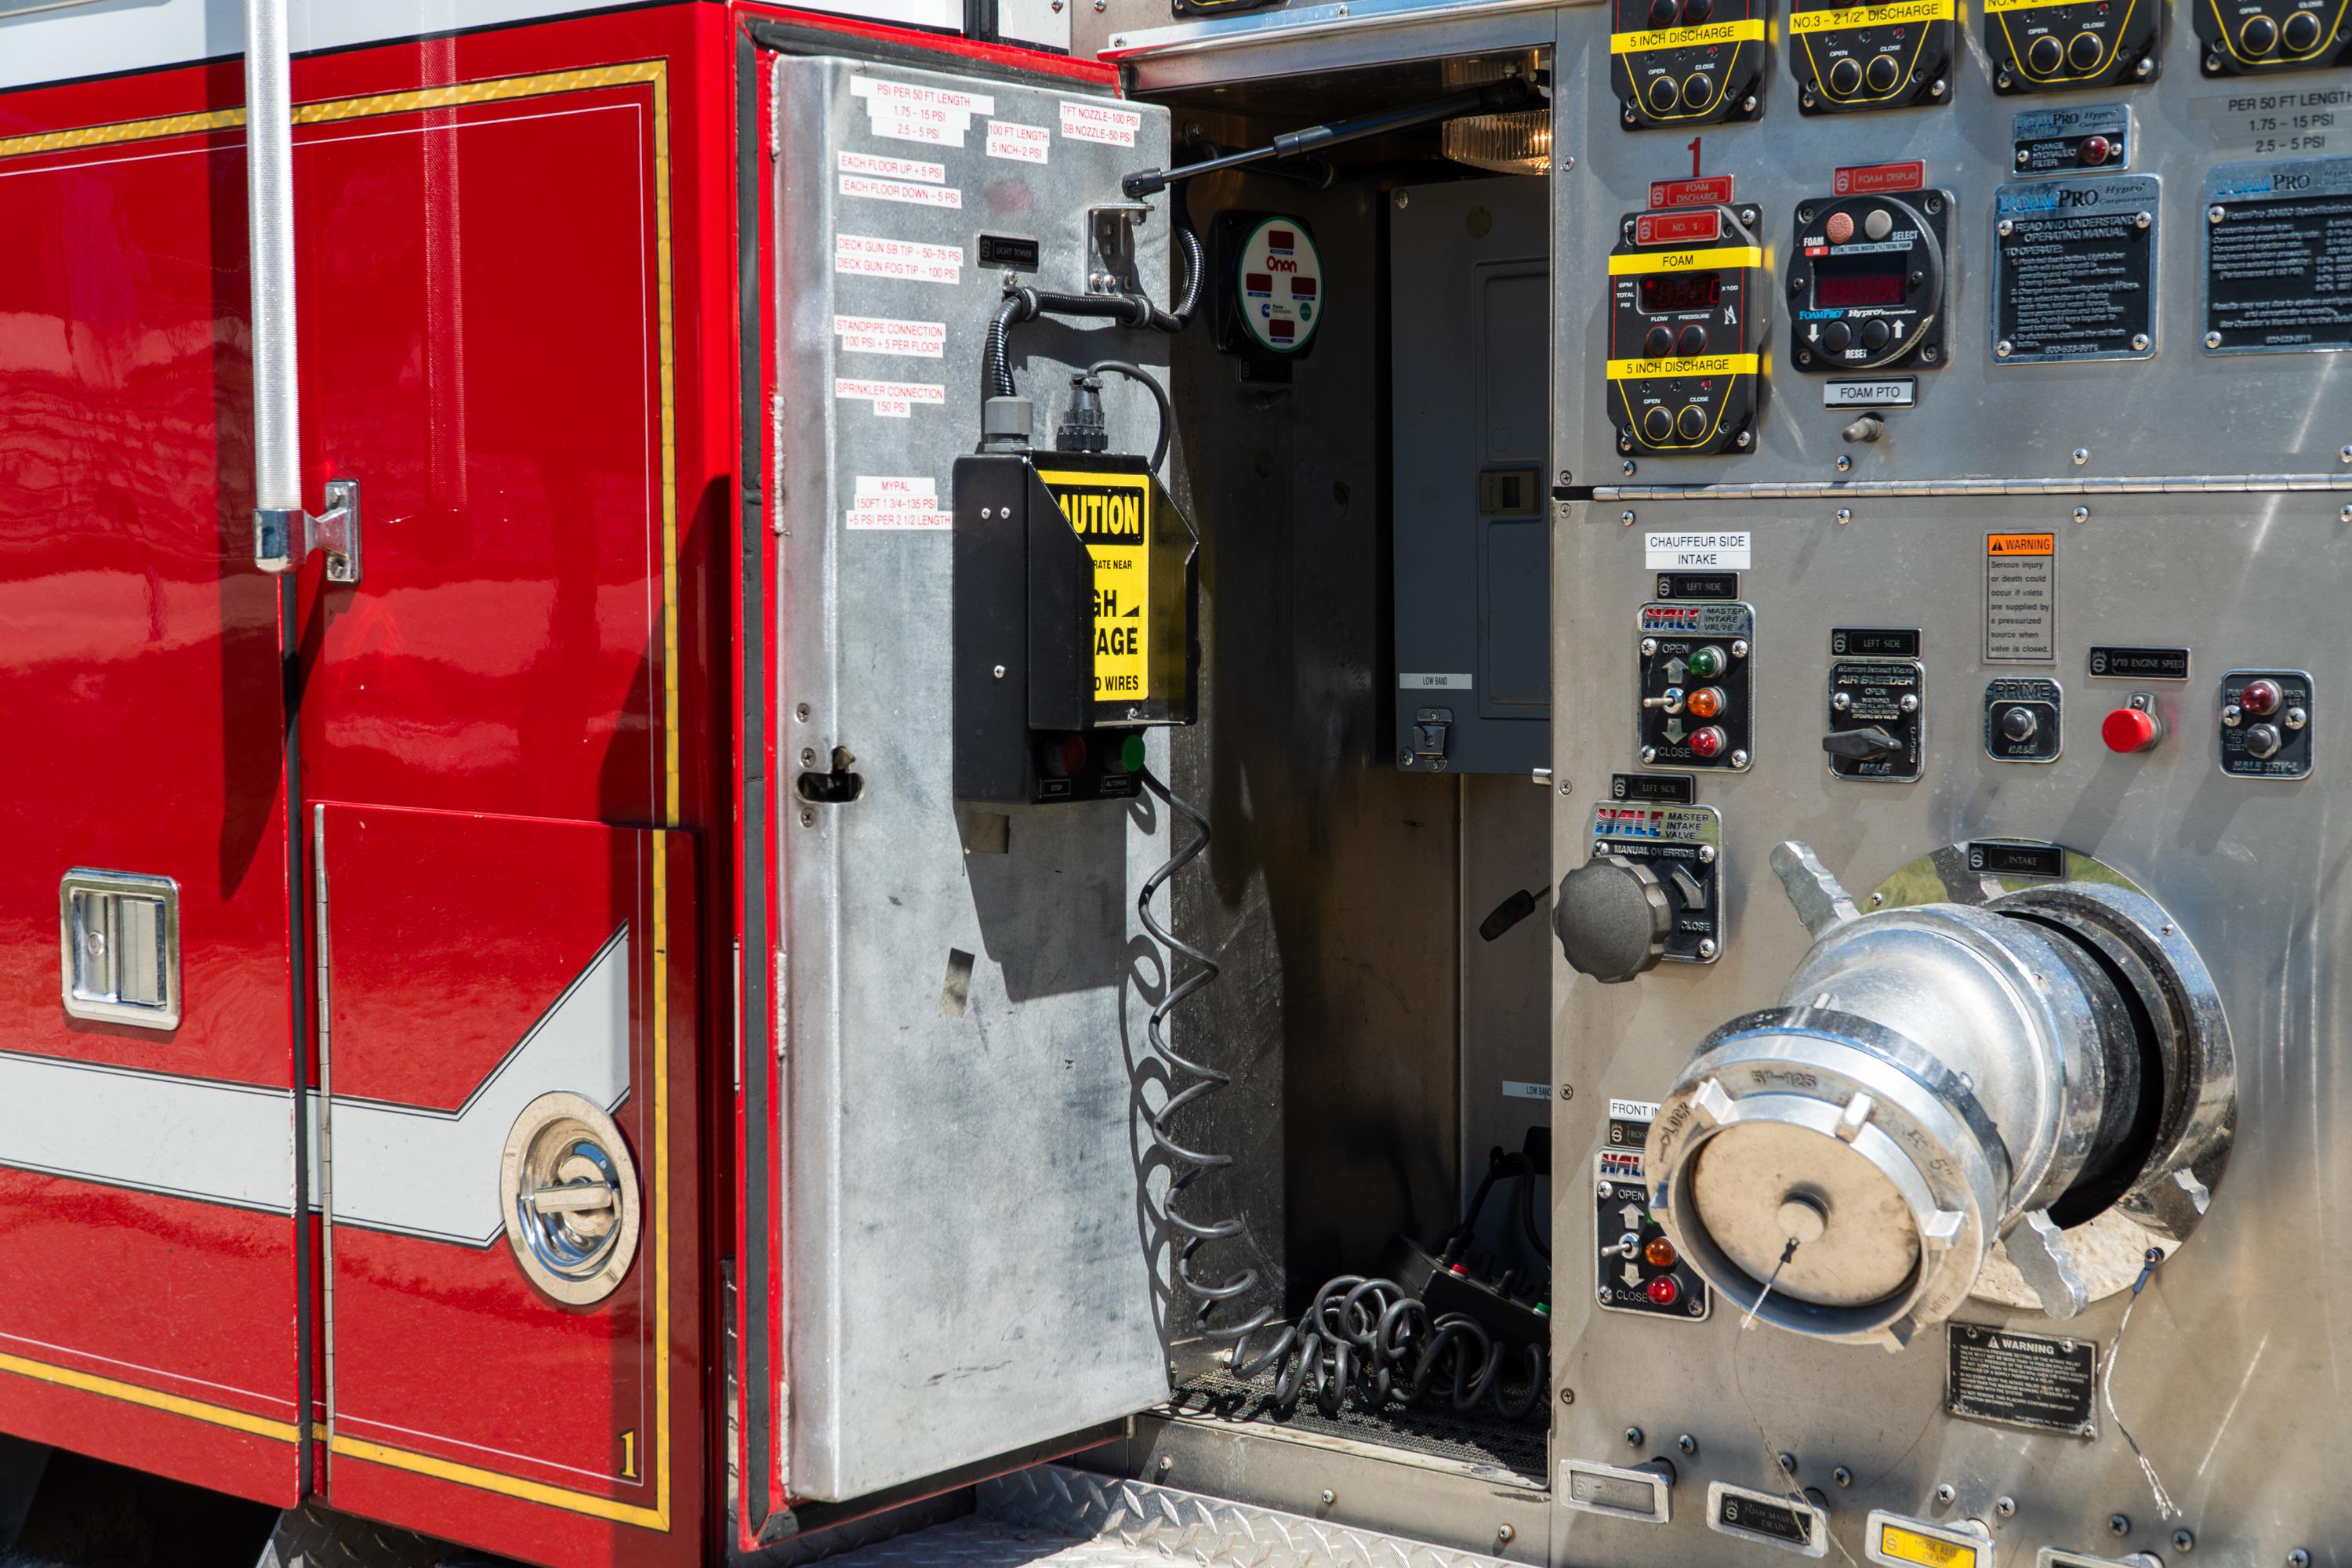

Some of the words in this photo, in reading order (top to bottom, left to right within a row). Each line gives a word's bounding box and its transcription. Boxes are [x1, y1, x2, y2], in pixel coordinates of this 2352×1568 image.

[1793, 16, 1820, 29] NO.3
[1868, 4, 1939, 21] DISCHARGE
[1630, 36, 1636, 47] 5
[1639, 33, 1666, 46] INCH
[1669, 26, 1735, 43] DISCHARGE
[877, 84, 891, 96] PSI
[894, 87, 911, 98] PER
[913, 89, 923, 100] 50
[925, 91, 935, 102] FT
[937, 93, 971, 107] LENGTH
[2228, 99, 2256, 111] PER
[2259, 97, 2276, 109] 50
[2279, 96, 2296, 107] FT
[894, 106, 911, 118] 1.75
[920, 109, 930, 120] 15
[932, 111, 946, 122] PSI
[1062, 105, 1076, 118] TFT
[1126, 115, 1138, 126] PSI
[2249, 118, 2276, 132] 1.75
[2292, 116, 2307, 128] 15
[2312, 114, 2335, 125] PSI
[898, 124, 910, 135] 2.5
[927, 128, 940, 140] PSI
[989, 125, 1002, 136] 100
[1004, 127, 1014, 138] FT
[1016, 129, 1048, 143] LENGTH
[1063, 123, 1074, 134] SB
[1120, 132, 1132, 143] PSI
[2032, 142, 2065, 151] CHANGE
[2256, 140, 2276, 153] 2.5
[2291, 138, 2299, 150] 5
[2303, 136, 2325, 148] PSI
[1029, 147, 1042, 158] PSI
[1687, 136, 1701, 177] 1
[841, 155, 866, 169] EACH
[868, 159, 898, 172] FLOOR
[900, 164, 912, 175] UP
[929, 168, 942, 179] PSI
[1858, 174, 1883, 184] FOAM
[1886, 172, 1917, 181] DISPLAY
[844, 180, 869, 192] EACH
[871, 183, 899, 195] FLOOR
[902, 187, 929, 199] DOWN
[946, 193, 959, 204] PSI
[1686, 183, 1709, 192] FOAM
[1676, 191, 1719, 203] DISCHARGE
[2015, 222, 2043, 232] READ
[2045, 220, 2066, 230] AND
[2067, 216, 2136, 229] UNDERSTAND
[1892, 230, 1919, 241] SELECT
[2024, 230, 2081, 242] OPERATING
[2082, 227, 2127, 238] MANUAL
[1803, 236, 1824, 247] FOAM
[839, 238, 862, 250] DECK
[865, 241, 884, 253] GUN
[887, 244, 898, 255] SB
[900, 245, 913, 255] TIP
[949, 250, 962, 262] PSI
[1266, 255, 1298, 273] Onan
[1662, 255, 1693, 267] FOAM
[837, 257, 861, 269] DECK
[863, 260, 883, 272] GUN
[885, 263, 903, 274] FOG
[905, 264, 919, 275] TIP
[928, 267, 942, 278] 100
[945, 269, 957, 280] PSI
[836, 319, 885, 333] STANDPIPE
[887, 323, 943, 337] CONNECTION
[844, 336, 859, 347] 100
[862, 337, 875, 347] PSI
[892, 339, 909, 350] PER
[912, 341, 940, 353] FLOOR
[1845, 349, 1867, 359] RESET
[1627, 364, 1632, 374] 5
[1635, 361, 1661, 373] INCH
[1665, 358, 1730, 372] DISCHARGE
[837, 383, 885, 396] SPRINKLER
[887, 386, 942, 399] CONNECTION
[1840, 387, 1873, 399] FOAM
[1877, 386, 1900, 397] PTO
[877, 401, 891, 412] 150
[894, 402, 907, 412] PSI
[881, 481, 910, 492] MYPAL
[923, 499, 936, 509] PSI
[861, 514, 874, 525] PSI
[877, 514, 894, 525] PER
[917, 515, 951, 526] LENGTH
[1058, 494, 1140, 535] AUTION
[1650, 536, 1716, 547] CHAUFFEUR
[1719, 535, 1745, 547] SIDE
[2005, 539, 2050, 550] WARNING
[1112, 559, 1133, 570] NEAR
[1678, 554, 1717, 564] INTAKE
[2022, 561, 2044, 571] injury
[2005, 603, 2038, 612] supplied
[2040, 603, 2050, 612] by
[1998, 617, 2042, 626] pressurized
[1662, 644, 1690, 654] OPEN
[1863, 639, 1880, 648] LEFT
[1884, 639, 1901, 648] SIDE
[2131, 659, 2158, 668] ENGINE
[1104, 675, 1139, 692] WIRES
[1422, 677, 1435, 686] LOW
[1435, 677, 1448, 686] BAND
[1993, 682, 2051, 698] PRIME
[1658, 746, 1691, 757] CLOSE
[1642, 784, 1658, 793] LEFT
[1661, 785, 1676, 793] SIDE
[1668, 812, 1710, 822] MASTER
[1666, 822, 1703, 831] INTAKE
[1665, 831, 1697, 840] VALVE
[1613, 844, 1650, 855] MANUAL
[1650, 846, 1695, 858] OVERRIDE
[2009, 856, 2039, 866] INTAKE
[1681, 920, 1711, 932] CLOSE
[1526, 1086, 1537, 1094] LOW
[1612, 1102, 1647, 1117] FRONT
[1618, 1189, 1645, 1201] OPEN
[1616, 1289, 1649, 1303] CLOSE
[2002, 1338, 2054, 1355] WARNING
[618, 1428, 639, 1479] 1
